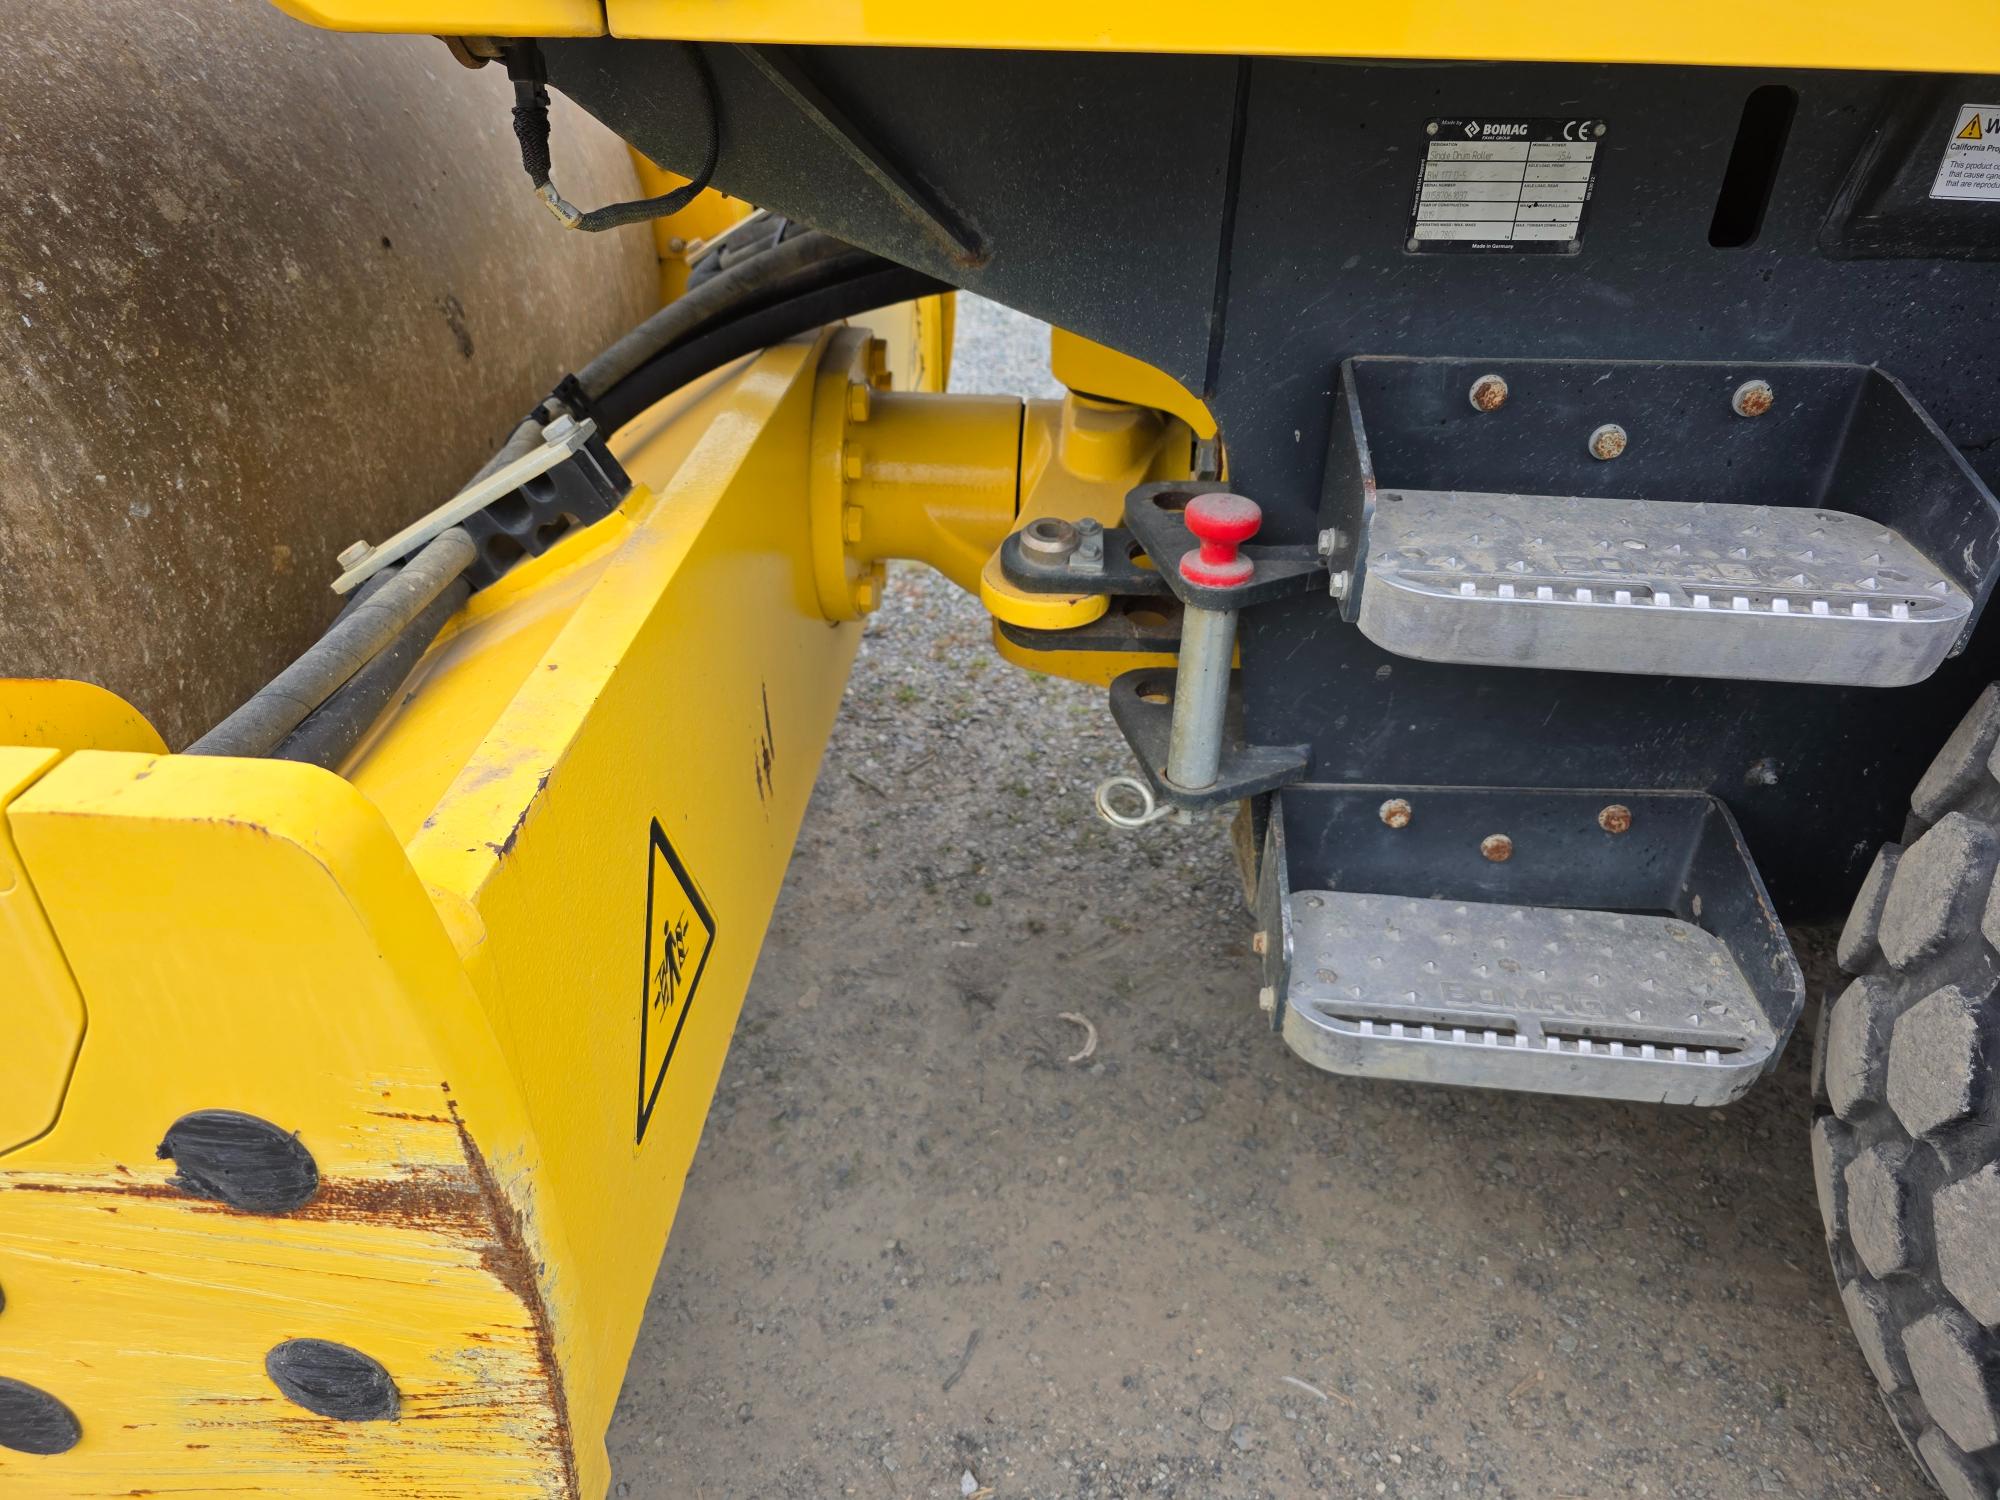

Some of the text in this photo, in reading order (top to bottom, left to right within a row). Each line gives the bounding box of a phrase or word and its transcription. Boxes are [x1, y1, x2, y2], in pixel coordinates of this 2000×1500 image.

[1483, 124, 1528, 135] BOMAG
[1564, 121, 1591, 140] CE
[1950, 143, 1985, 152] California
[1453, 150, 1471, 160] Drum
[1472, 150, 1494, 160] Roller
[1951, 160, 1964, 168] This
[1964, 162, 1993, 171] product
[1948, 170, 1962, 178] that
[1945, 179, 1959, 187] that
[1439, 979, 1607, 1018] BOMAG
